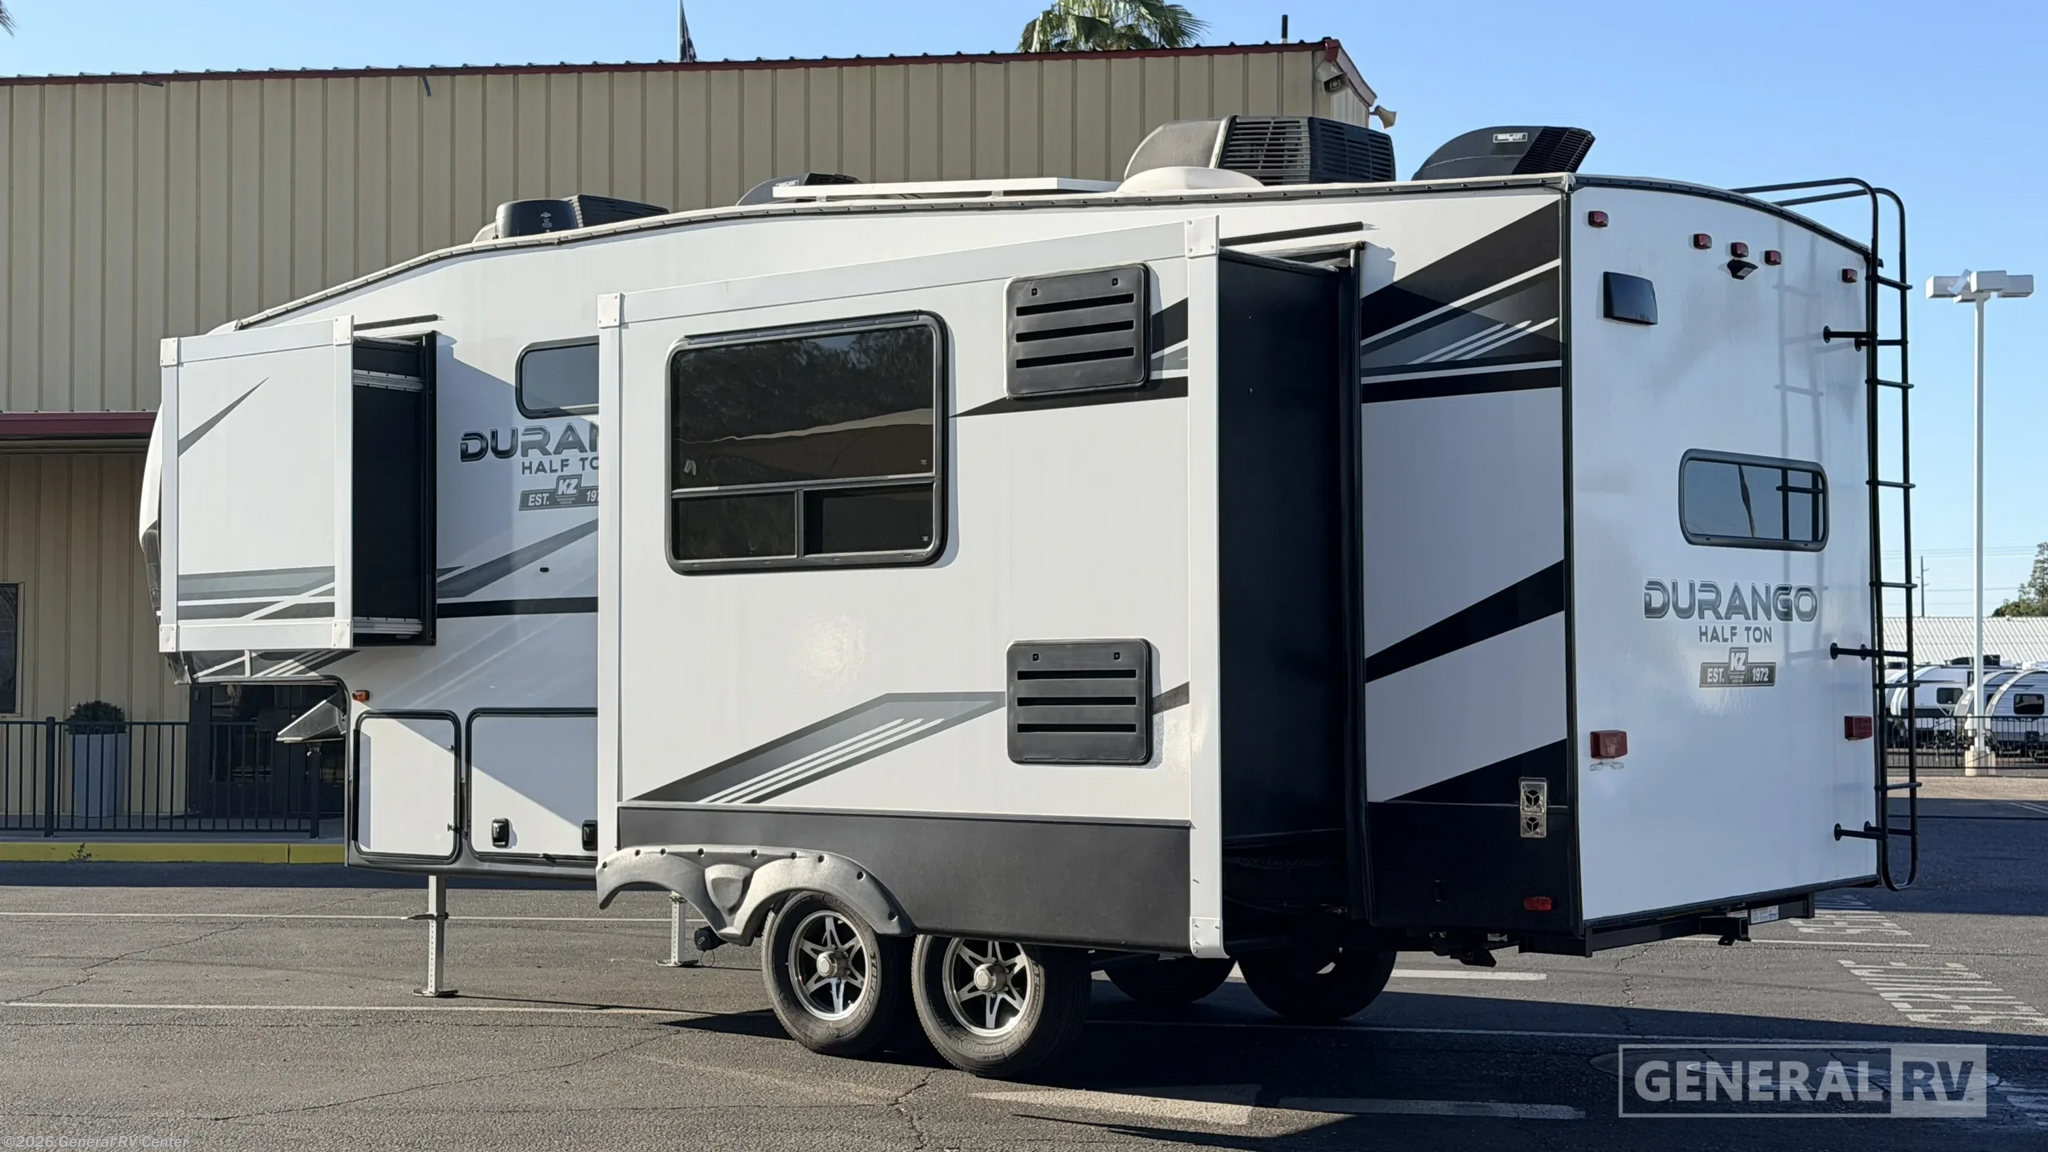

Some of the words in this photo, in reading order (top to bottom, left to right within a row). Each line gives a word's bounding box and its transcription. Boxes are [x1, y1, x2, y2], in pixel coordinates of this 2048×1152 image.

[522, 459, 570, 475] HALF
[557, 478, 579, 495] KZ
[528, 493, 550, 506] EST.
[586, 489, 599, 503] 19
[1644, 579, 1818, 622] DURANGO
[1698, 625, 1737, 643] HALF
[1744, 626, 1773, 643] TON
[1730, 652, 1746, 671] KZ
[1707, 668, 1725, 682] EST.
[1752, 667, 1769, 682] 1972
